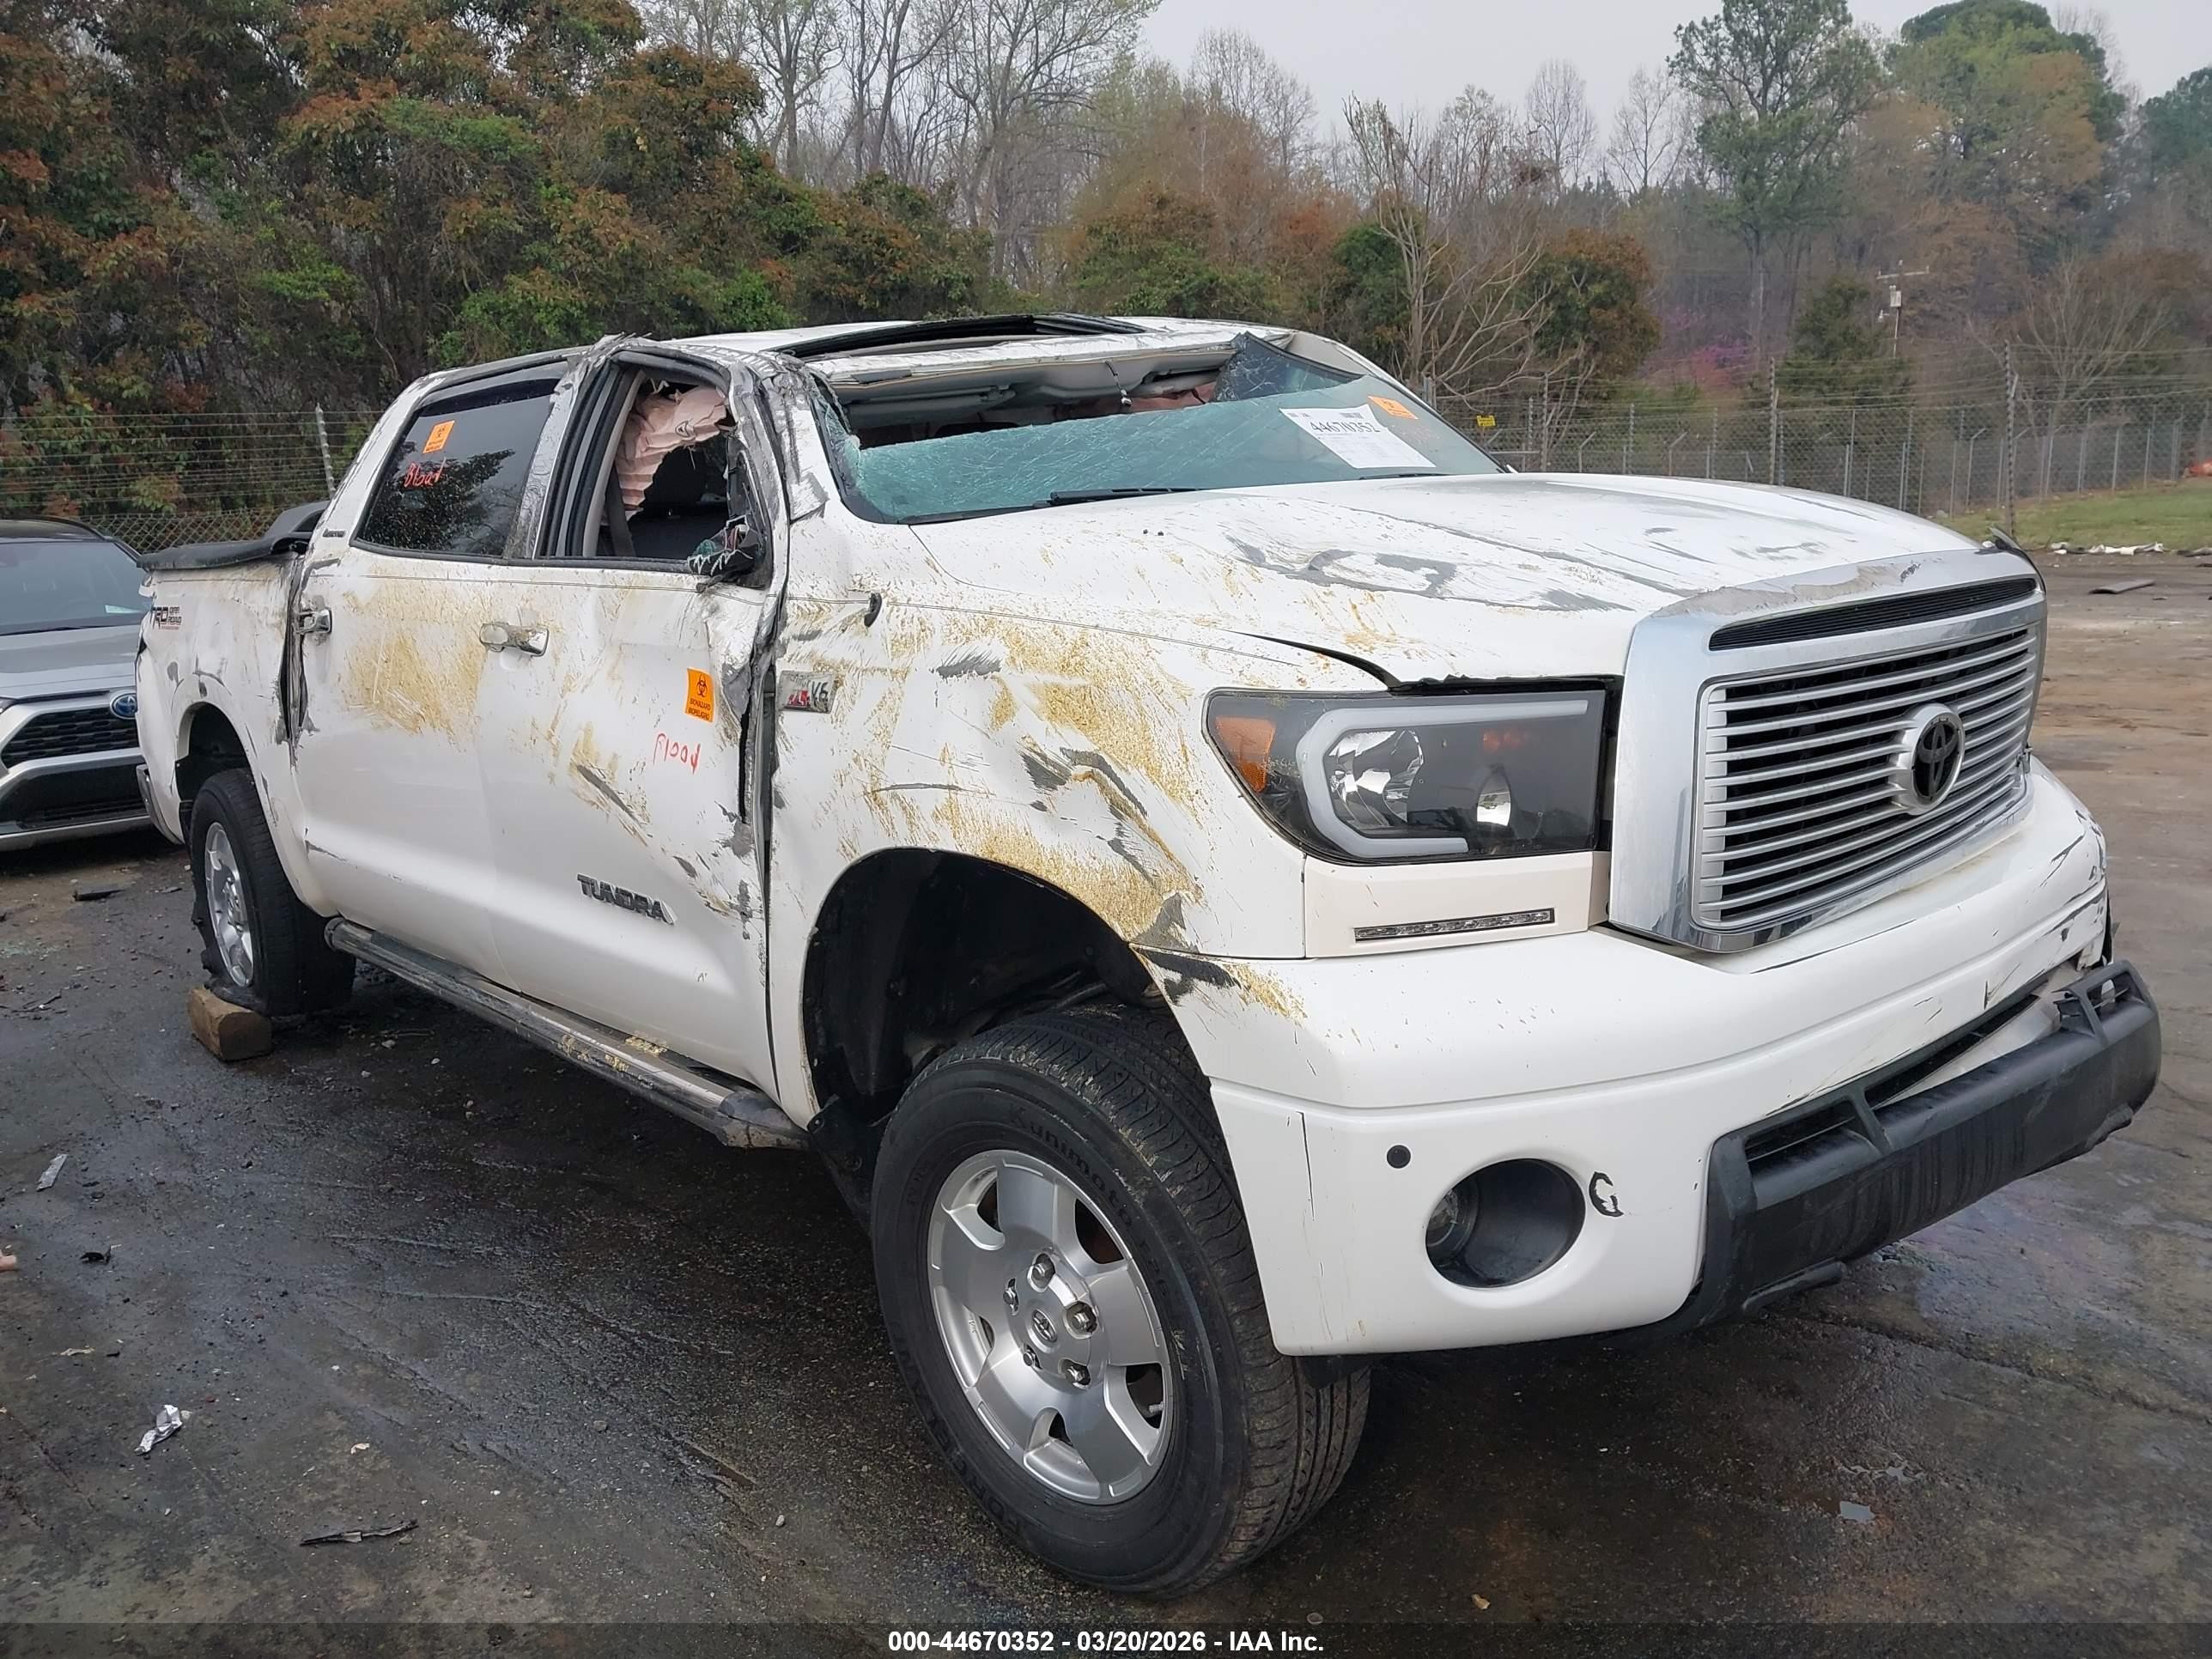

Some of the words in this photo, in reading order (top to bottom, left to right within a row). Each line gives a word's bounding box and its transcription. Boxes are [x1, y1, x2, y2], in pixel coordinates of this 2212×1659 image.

[1310, 422, 1381, 433] 44670352
[151, 606, 168, 629] TRD
[576, 872, 675, 925] TUNDRA
